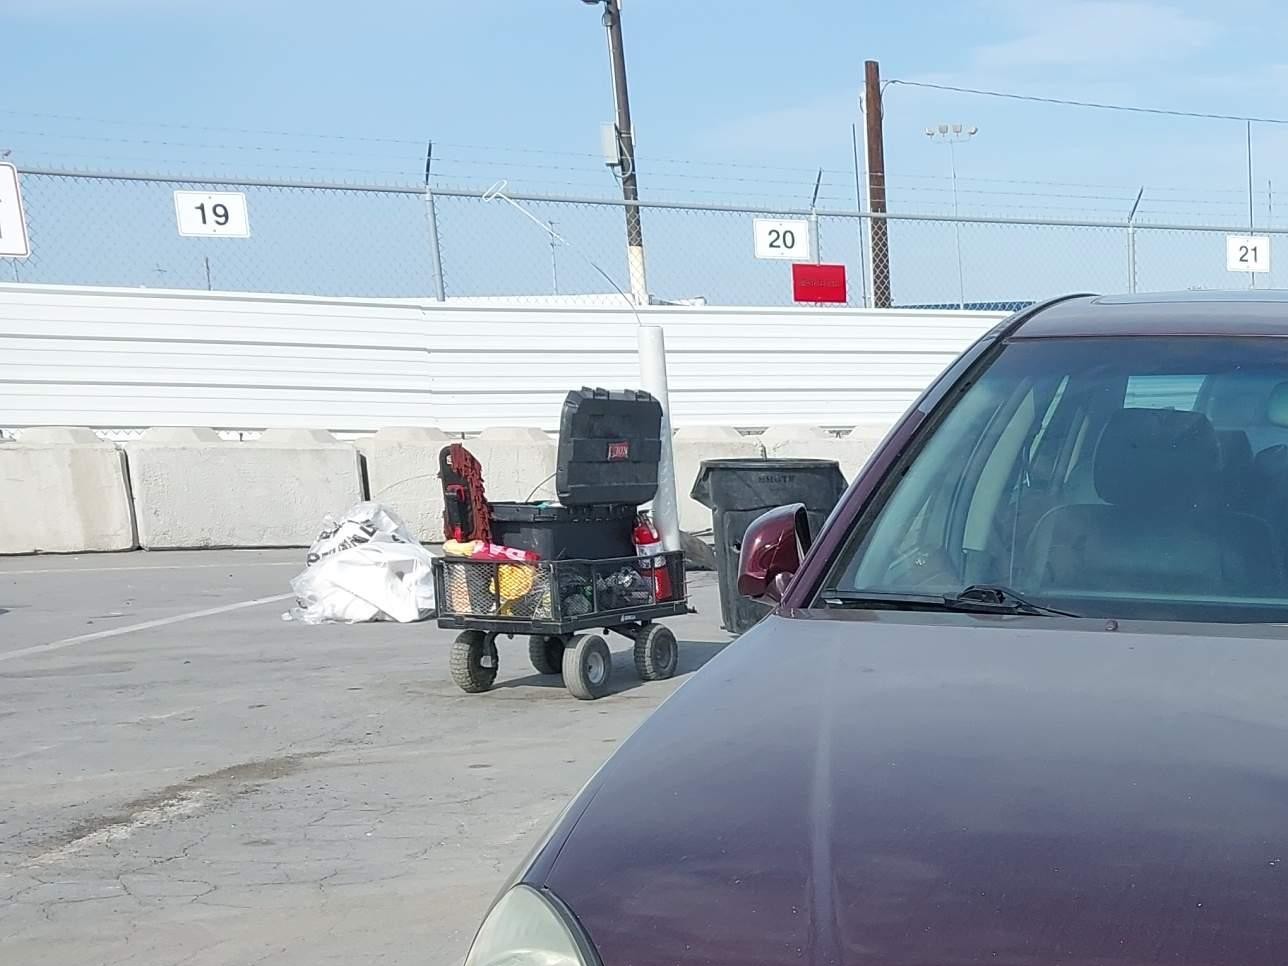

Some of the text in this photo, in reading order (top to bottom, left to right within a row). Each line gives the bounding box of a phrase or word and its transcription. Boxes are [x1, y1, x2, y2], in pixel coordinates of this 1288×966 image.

[194, 202, 229, 226] 19
[767, 229, 796, 249] 20
[1239, 245, 1258, 263] 21
